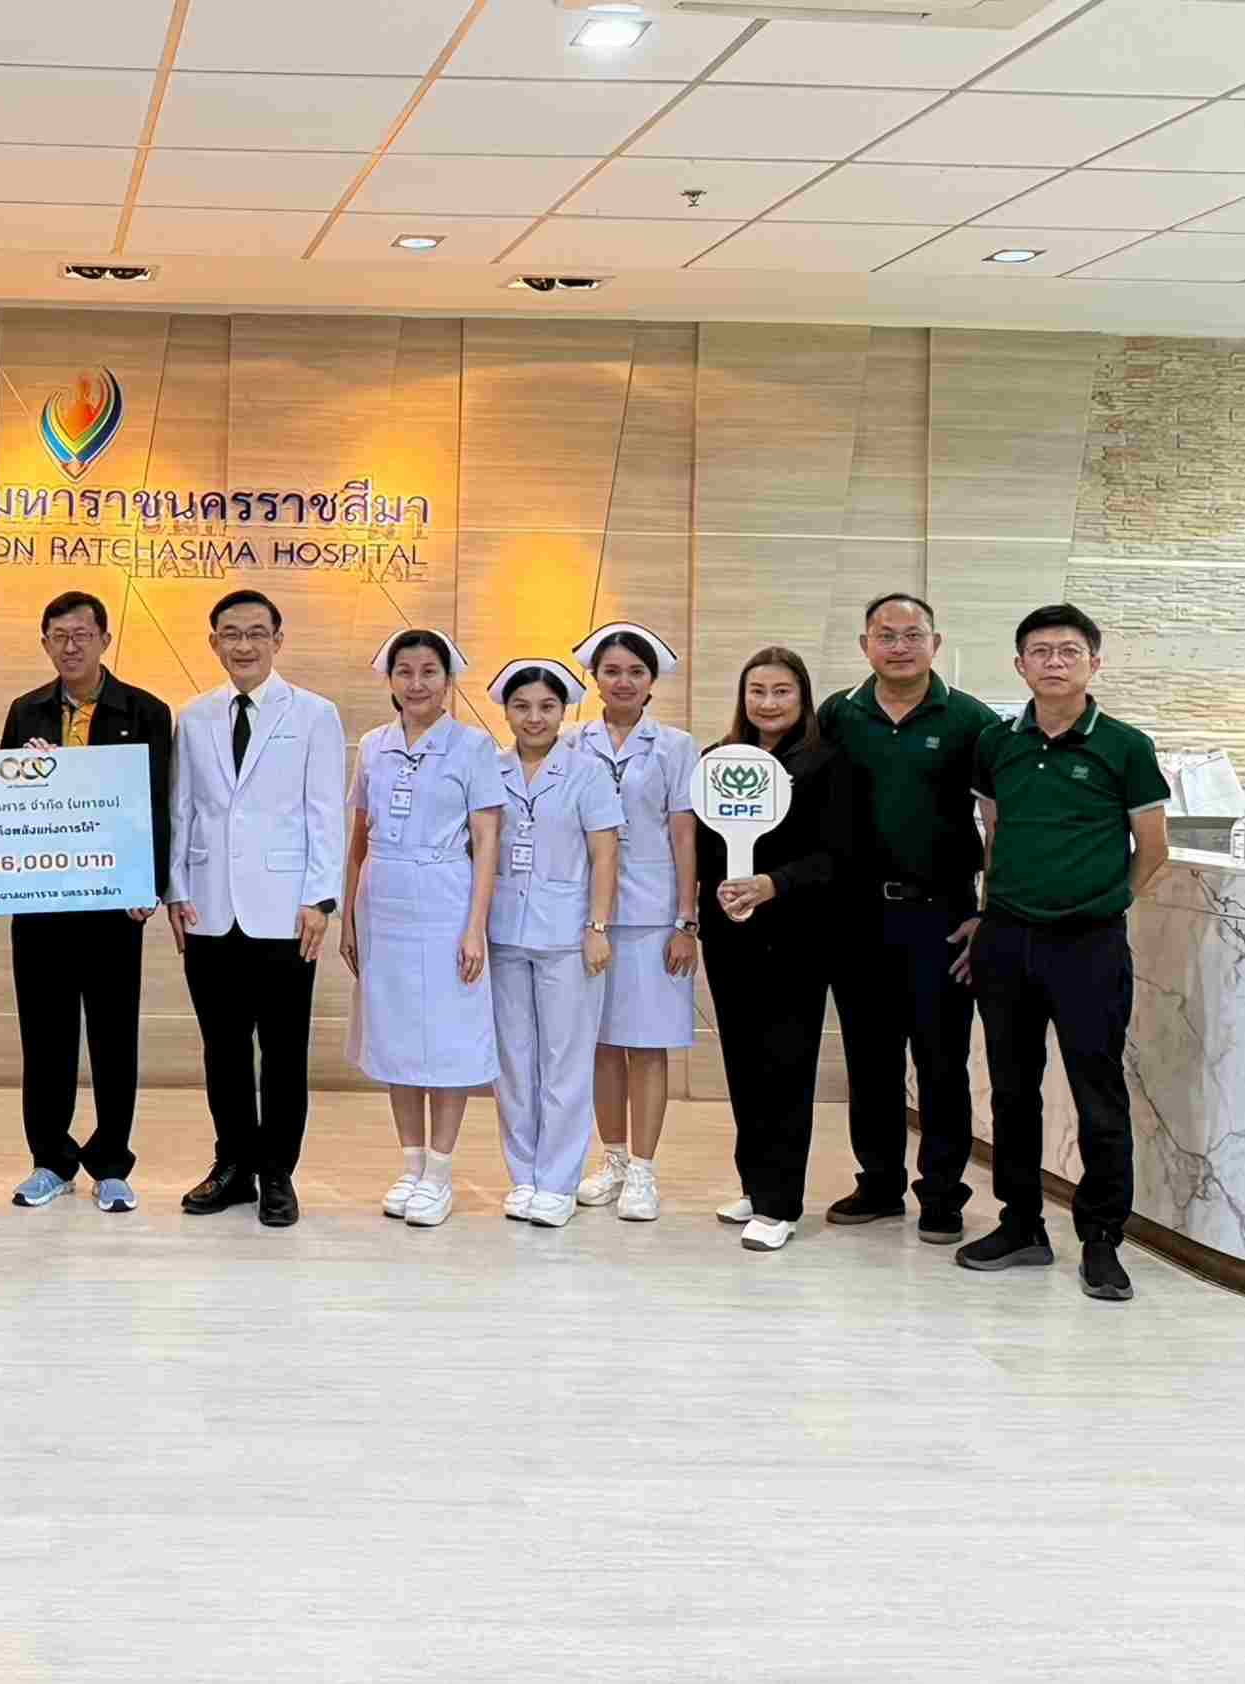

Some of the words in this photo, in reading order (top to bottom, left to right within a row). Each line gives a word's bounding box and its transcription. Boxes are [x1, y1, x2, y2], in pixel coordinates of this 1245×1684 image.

[50, 535, 257, 565] RATCHASIMA
[273, 541, 428, 566] HOSPITAL
[719, 803, 763, 816] CPF
[76, 854, 114, 867] บาท
